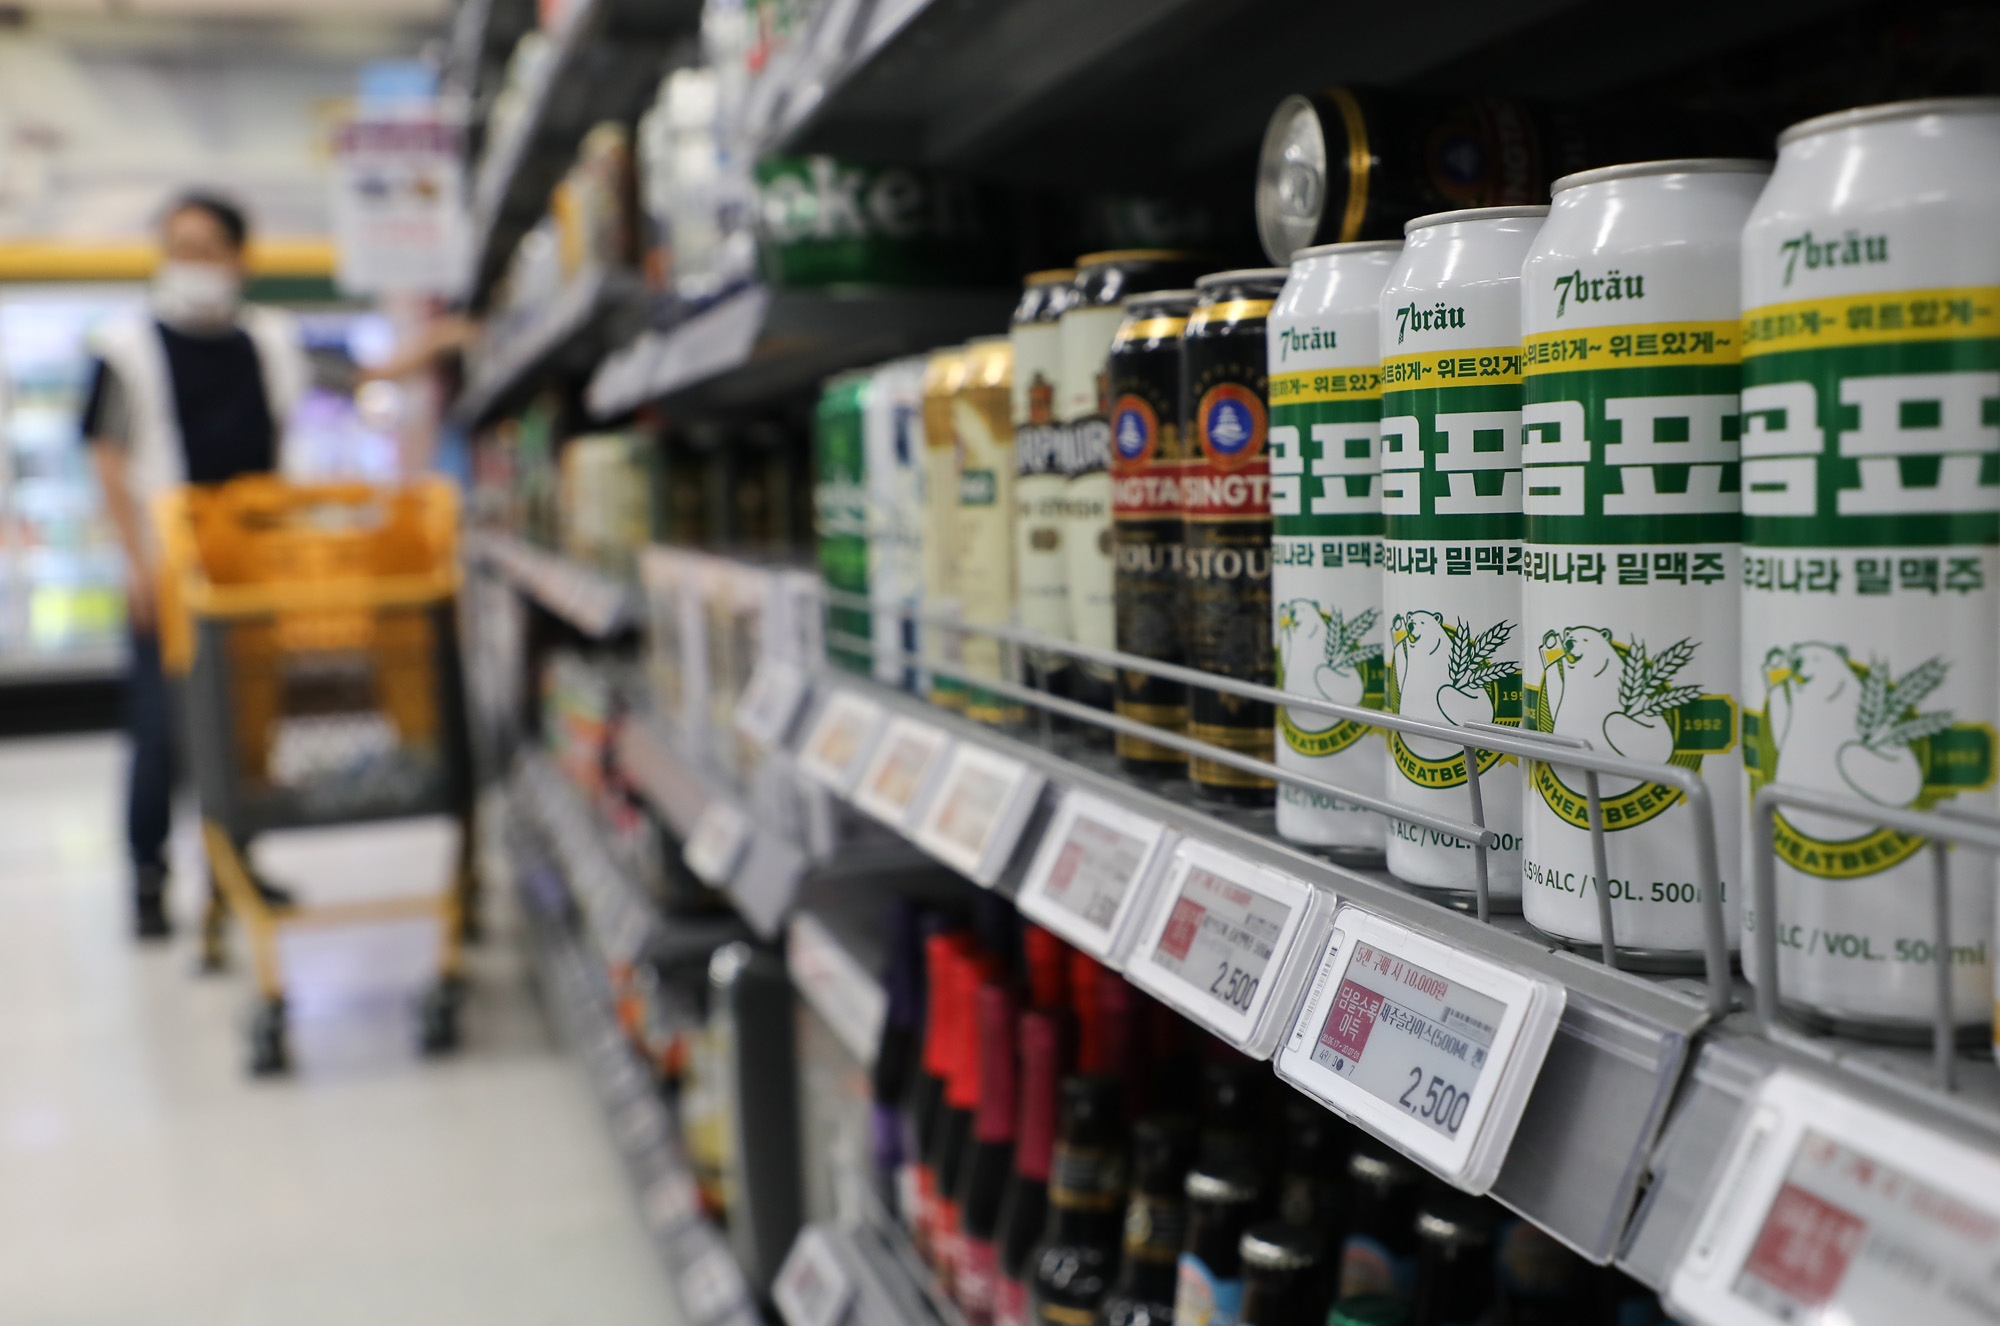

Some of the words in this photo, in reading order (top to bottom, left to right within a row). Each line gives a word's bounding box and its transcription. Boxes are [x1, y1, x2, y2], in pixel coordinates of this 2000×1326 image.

[1780, 230, 1888, 287] 7bräu
[1553, 268, 1645, 319] 7bräu
[1396, 301, 1466, 345] 7bräu
[1281, 327, 1338, 362] 7bräu
[1608, 330, 1732, 358] 위트있게~
[1523, 550, 1607, 584] 우리나라
[1617, 551, 1726, 586] 밀맥주
[1855, 556, 1985, 596] 밀맥주
[1684, 717, 1722, 731] 1952
[1540, 769, 1672, 824] WHEABEER
[1545, 868, 1576, 893] ALC
[1210, 960, 1259, 1012] 2,500
[1374, 952, 1392, 977] 구매
[1391, 962, 1404, 982] 시
[1338, 986, 1380, 1024] 담을수록
[1339, 1013, 1362, 1042] 이득
[1398, 1066, 1470, 1134] 2,500
